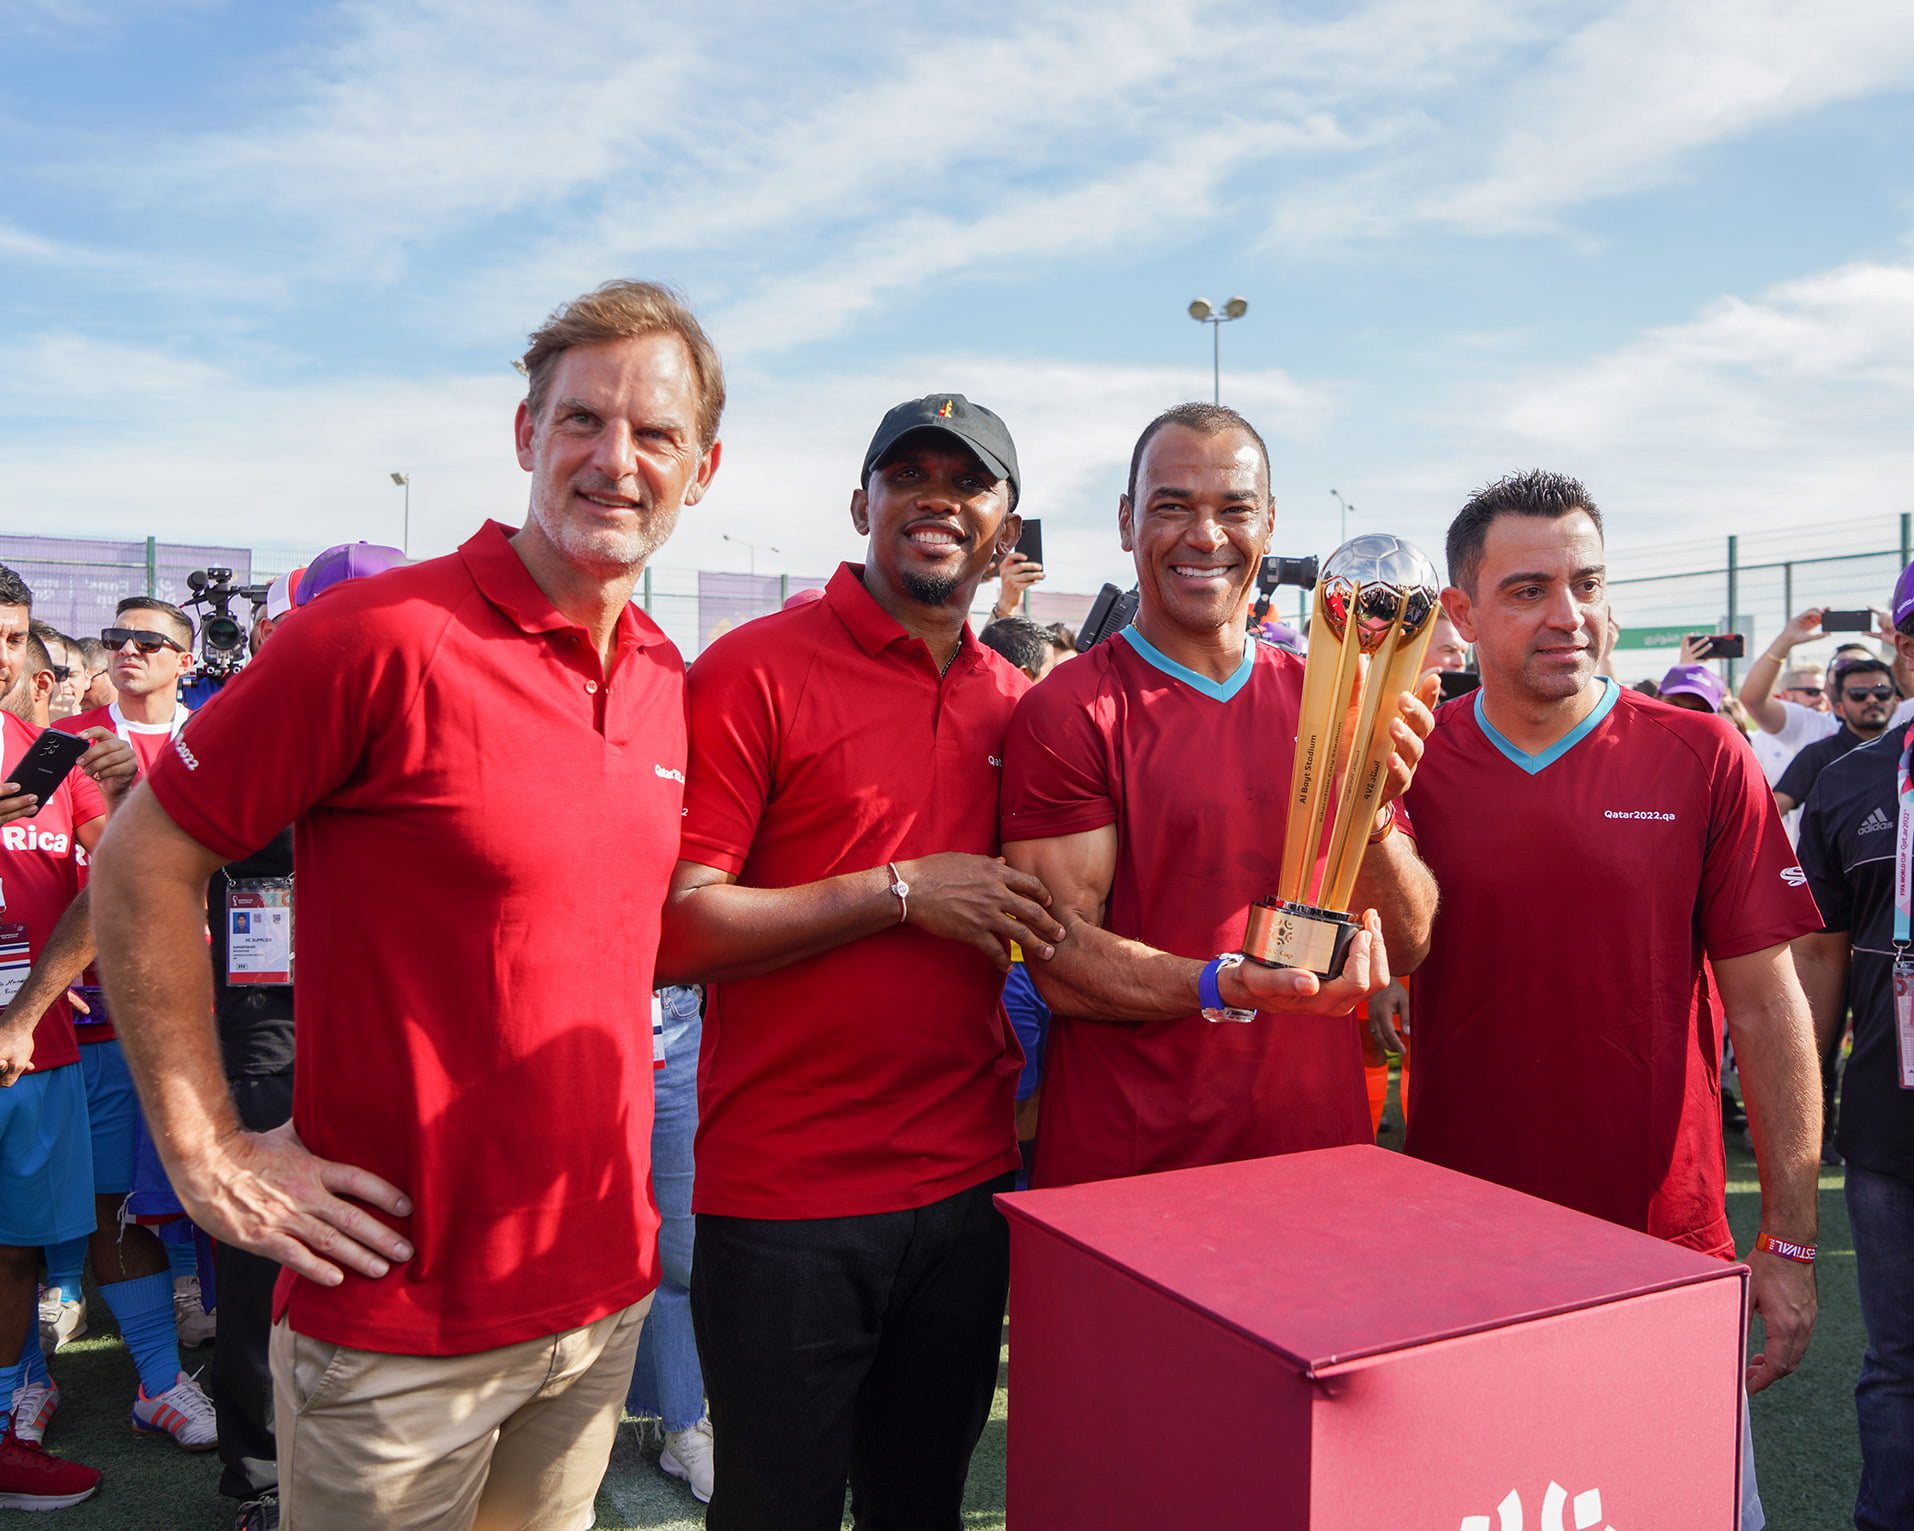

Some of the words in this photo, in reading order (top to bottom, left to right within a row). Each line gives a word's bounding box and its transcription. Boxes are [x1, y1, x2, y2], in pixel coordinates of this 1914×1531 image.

[1304, 734, 1317, 772] Stadium
[1300, 772, 1312, 794] Bayt
[1299, 794, 1307, 804] Al
[1604, 810, 1675, 822] Qatar2022.qa
[1857, 821, 1894, 836] adidas
[2, 824, 69, 853] Rica
